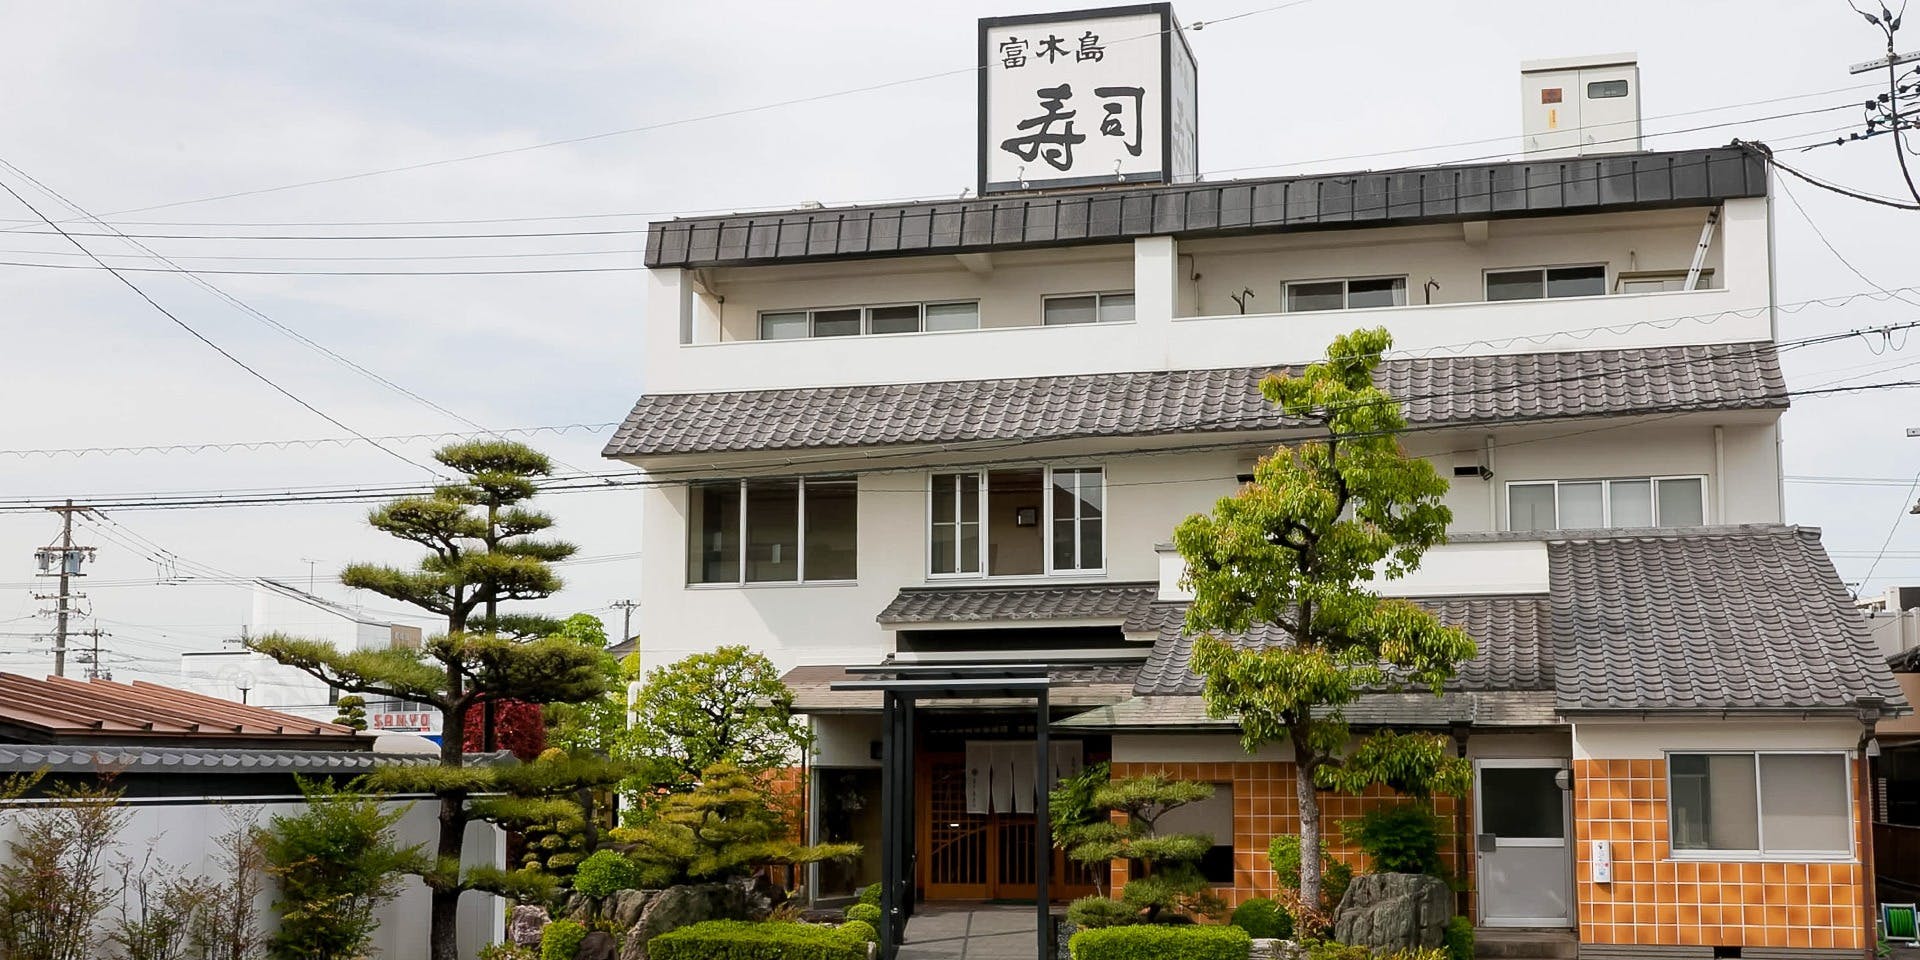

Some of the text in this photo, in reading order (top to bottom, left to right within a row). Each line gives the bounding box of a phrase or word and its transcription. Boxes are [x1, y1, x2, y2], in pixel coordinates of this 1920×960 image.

[1000, 31, 1106, 69] 富木島
[1000, 83, 1145, 171] 寿司
[374, 713, 430, 727] SANYO
